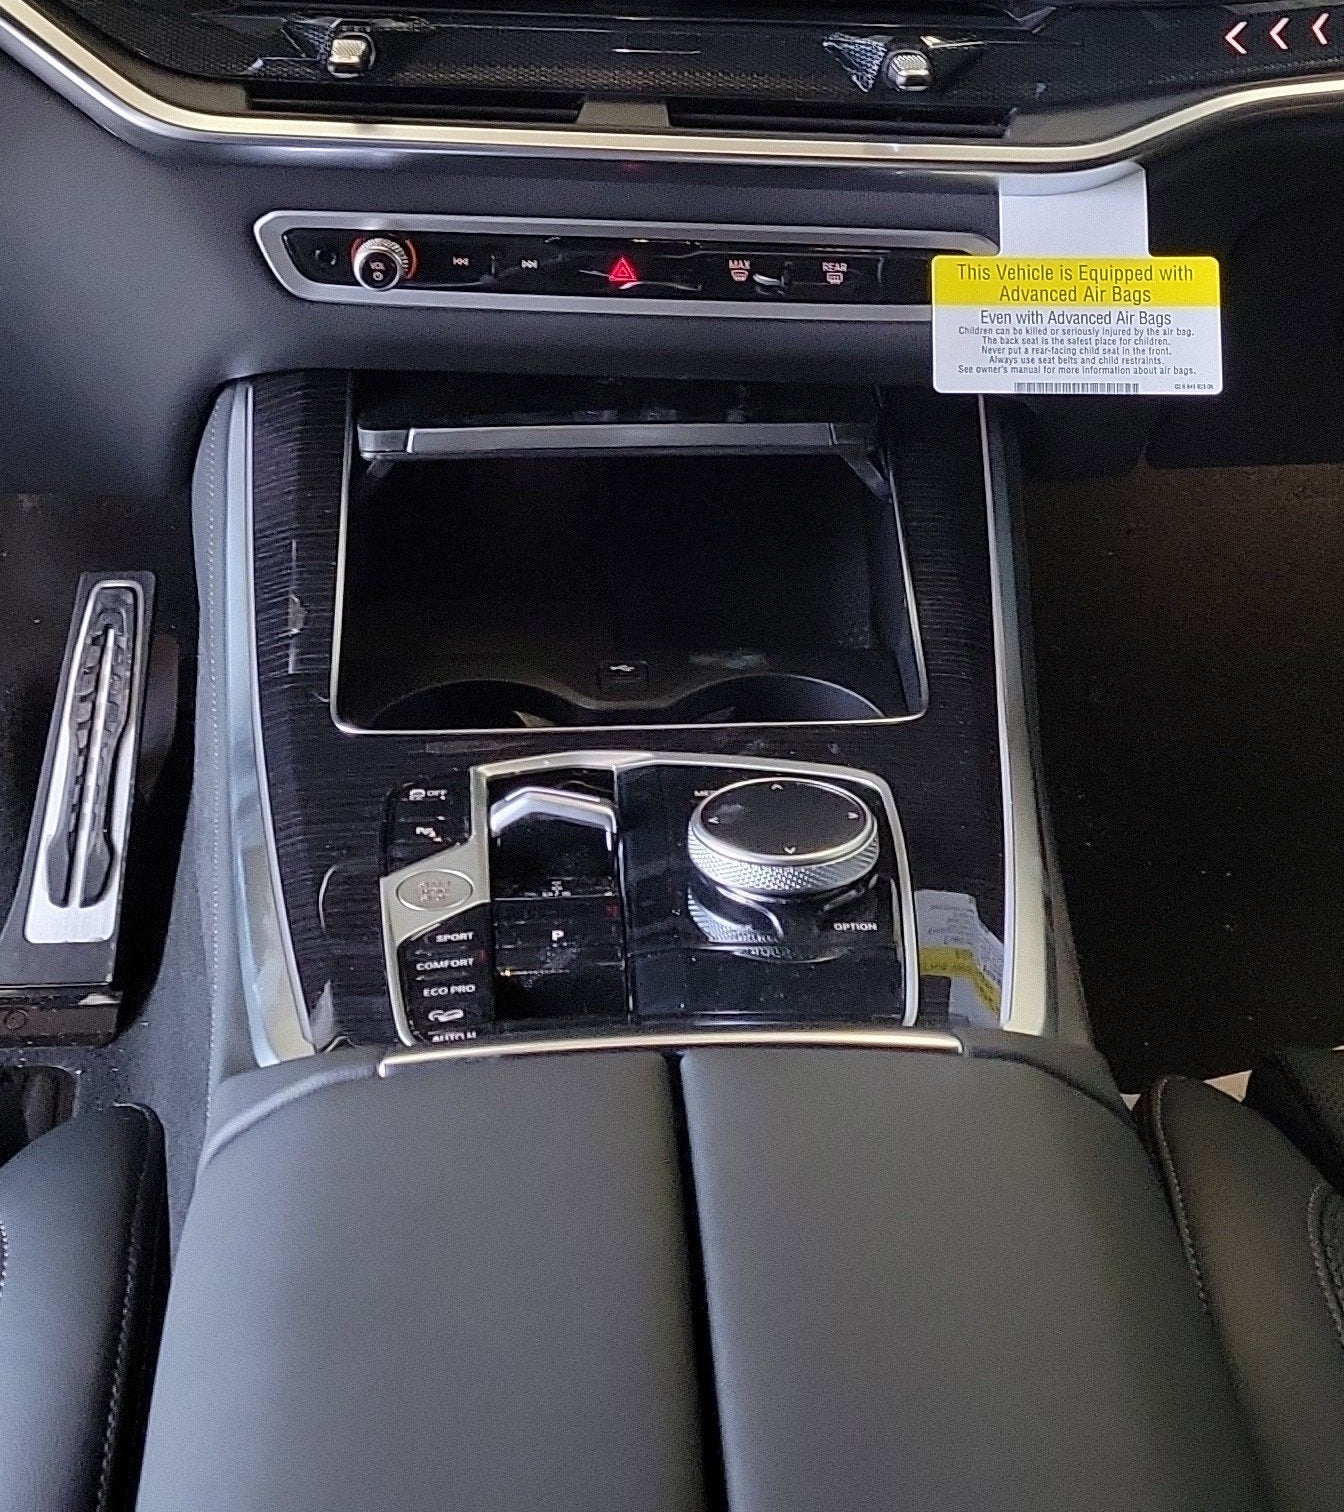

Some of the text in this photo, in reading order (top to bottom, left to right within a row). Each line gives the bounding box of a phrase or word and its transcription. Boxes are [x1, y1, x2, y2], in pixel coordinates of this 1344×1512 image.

[728, 259, 751, 269] MAX
[822, 262, 847, 272] REAR
[957, 264, 1193, 284] This Vehicle is Equipped with
[999, 285, 1151, 305] Advanced Air Bags
[981, 310, 1171, 327] Even with Advanced Air Bags
[958, 326, 992, 335] Children
[1013, 326, 1022, 335] be
[1025, 326, 1047, 335] killed
[1062, 326, 1099, 337] seriously
[1102, 327, 1131, 337] injured
[1134, 327, 1144, 338] by
[1147, 327, 1159, 336] the
[1162, 327, 1173, 336] air
[1176, 327, 1194, 337] bag.
[982, 336, 1170, 347] The back seat is the safest place for children.
[981, 346, 1005, 354] Never
[1008, 346, 1022, 356] put
[1031, 346, 1076, 356] rear-facing
[1079, 346, 1099, 355] child
[1102, 347, 1119, 355] seat
[1122, 347, 1130, 355] in
[1133, 347, 1146, 355] the
[1148, 347, 1172, 355] front.
[989, 356, 1018, 365] Always
[1038, 356, 1055, 364] seat
[1058, 356, 1078, 364] belts
[1080, 356, 1096, 364] and
[1098, 357, 1119, 365] child
[1121, 357, 1164, 365] restraints.
[958, 365, 973, 373] See
[976, 365, 1008, 374] owner's
[1011, 366, 1041, 374] manual
[1043, 366, 1055, 374] for
[1082, 366, 1130, 374] information
[1133, 366, 1157, 374] about
[1159, 366, 1171, 374] air
[1174, 366, 1196, 376] bags.
[833, 921, 878, 931] OPTION
[436, 931, 474, 943] SPORT
[552, 930, 565, 941] P
[416, 957, 474, 971] COMFORT
[423, 984, 476, 997] ECO PRO
